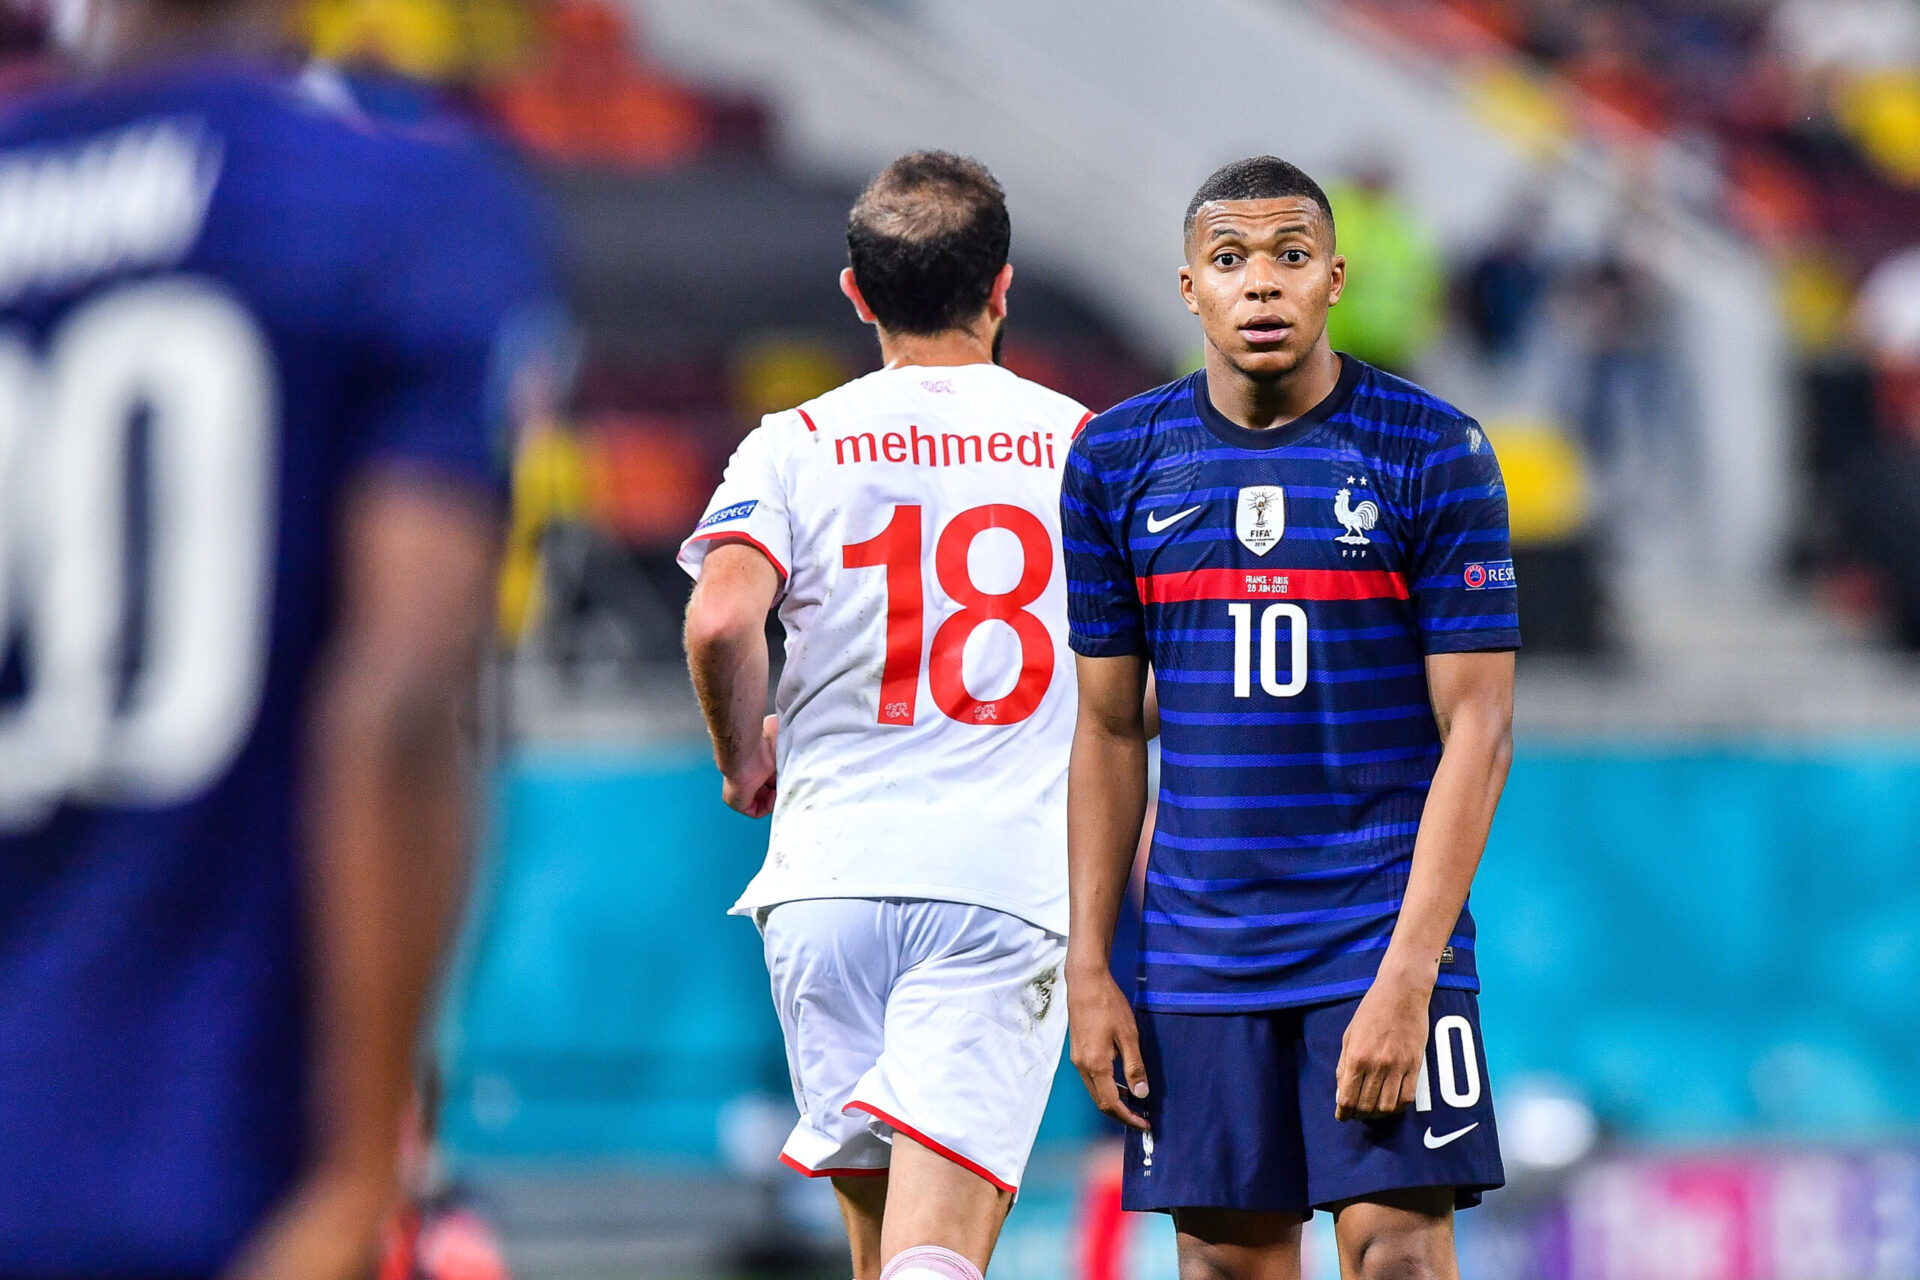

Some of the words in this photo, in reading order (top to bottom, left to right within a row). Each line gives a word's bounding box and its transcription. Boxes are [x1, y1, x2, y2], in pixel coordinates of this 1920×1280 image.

[835, 425, 1055, 469] mehmedi
[1250, 530, 1270, 538] FIFA
[1245, 575, 1267, 584] FRANCE
[1247, 584, 1257, 593] 28
[1258, 584, 1271, 593] JUIN
[1271, 585, 1288, 593] 2021
[842, 503, 1055, 726] 18
[1228, 603, 1308, 698] 10
